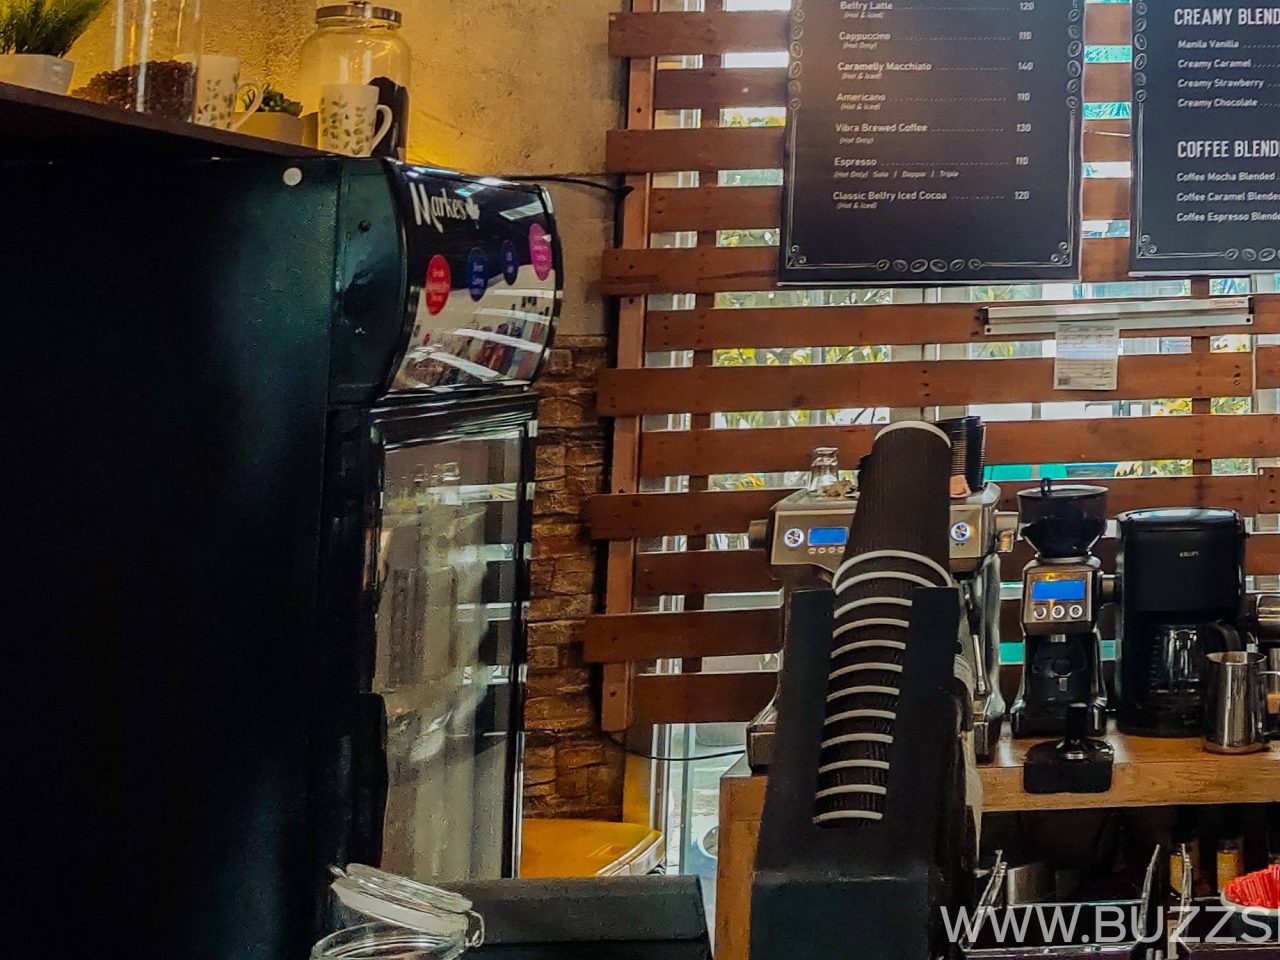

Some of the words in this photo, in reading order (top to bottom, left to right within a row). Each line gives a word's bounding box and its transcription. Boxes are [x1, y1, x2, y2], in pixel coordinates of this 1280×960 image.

[840, 0, 868, 12] Belfry
[869, 0, 894, 10] Latte
[1019, 1, 1035, 11] 120
[1174, 8, 1232, 26] CREAMY
[839, 31, 891, 43] Cappuccino
[1018, 31, 1032, 41] 110
[1177, 39, 1207, 49] Manila
[1208, 39, 1240, 49] Vanilla
[837, 61, 885, 72] Caramelly
[886, 61, 932, 72] Macchiato
[1017, 61, 1034, 71] 140
[1177, 59, 1212, 70] Creamy
[1213, 58, 1251, 68] Caramel
[1177, 78, 1212, 90] Creamy
[1213, 78, 1264, 89] Strawberry
[836, 92, 886, 102] Americano
[1017, 92, 1031, 102] 110
[1177, 98, 1212, 109] Creamy
[1213, 97, 1258, 108] Chocolate
[835, 123, 861, 133] Vibra
[862, 123, 897, 133] Brewed
[898, 123, 928, 133] Coffee
[1016, 123, 1032, 133] 130
[1177, 140, 1229, 159] COFFEE
[834, 157, 877, 168] Espresso
[1015, 156, 1029, 166] 110
[1176, 172, 1205, 182] Coffee
[1207, 172, 1237, 182] Mocha
[1238, 171, 1276, 181] Blended
[833, 191, 866, 201] Classic
[868, 191, 896, 203] Belfry
[897, 191, 917, 201] Iced
[918, 191, 948, 201] Cocoa
[1014, 191, 1030, 200] 120
[1176, 192, 1205, 202] Coffee
[1207, 192, 1245, 202] Caramel
[1176, 212, 1205, 222] Coffee
[1207, 212, 1250, 224] Espresso
